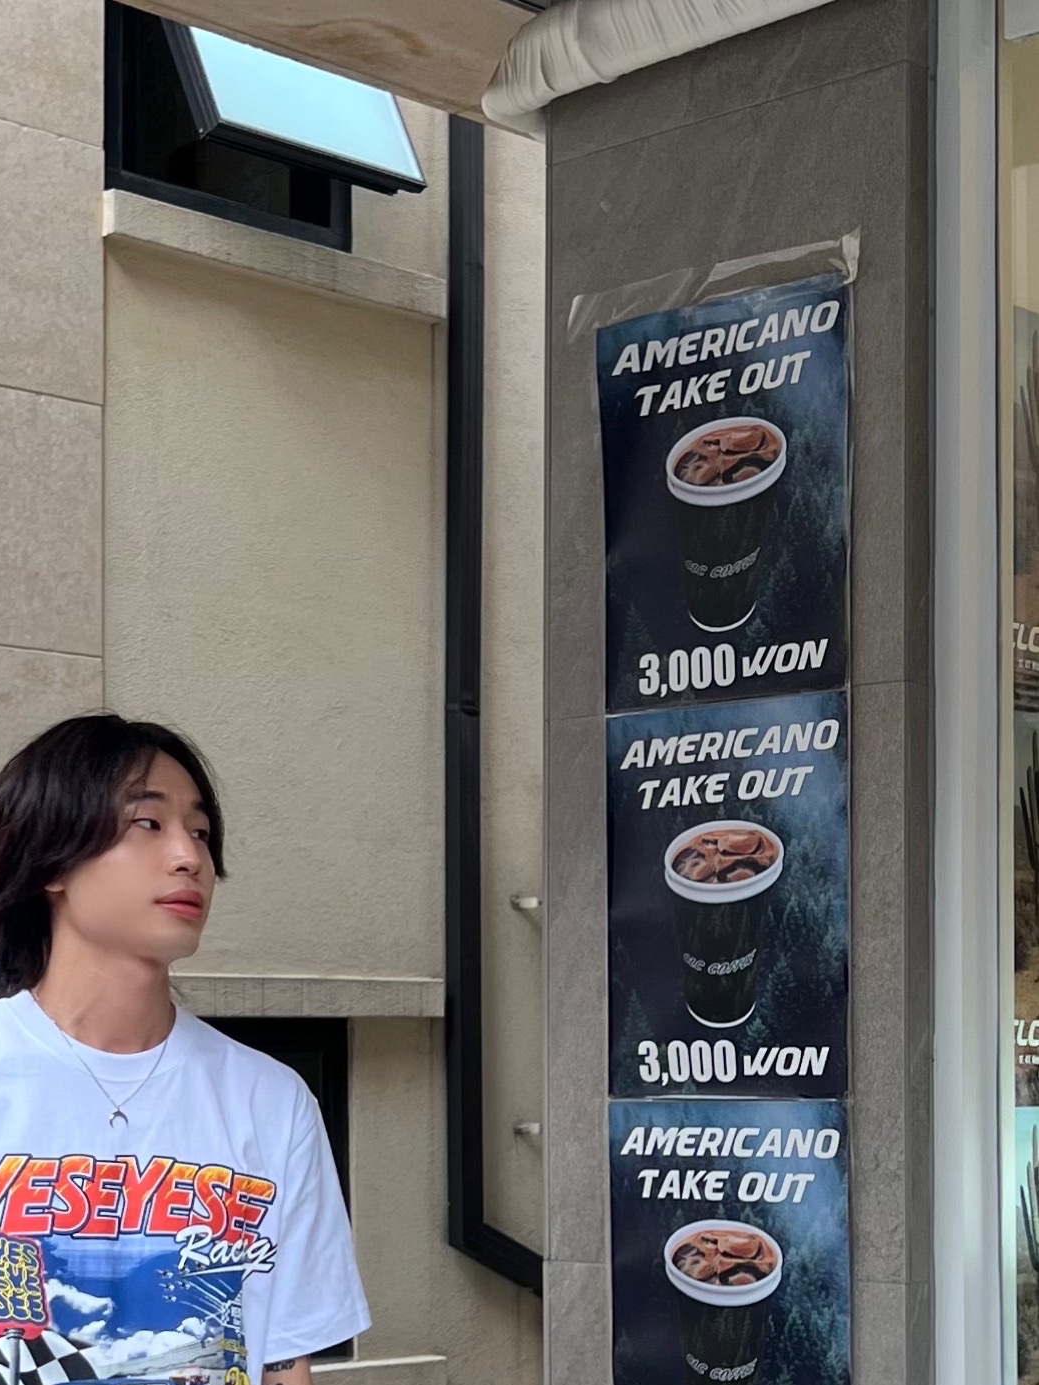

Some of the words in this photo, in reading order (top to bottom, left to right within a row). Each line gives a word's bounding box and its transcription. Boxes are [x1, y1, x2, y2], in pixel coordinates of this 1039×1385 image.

[611, 299, 841, 378] AMERICANO
[635, 365, 732, 417] TAKE
[738, 350, 811, 395] OUT
[638, 643, 736, 698] 3,000
[742, 638, 829, 678] WON
[620, 719, 841, 771] AMERICANO
[638, 771, 730, 810] TAKE
[737, 764, 815, 801] OUT
[638, 1038, 737, 1087] 3,000
[743, 1046, 830, 1077] WON
[620, 1126, 841, 1159] AMERICANO
[637, 1169, 731, 1201] TAKE
[738, 1171, 816, 1203] OUT
